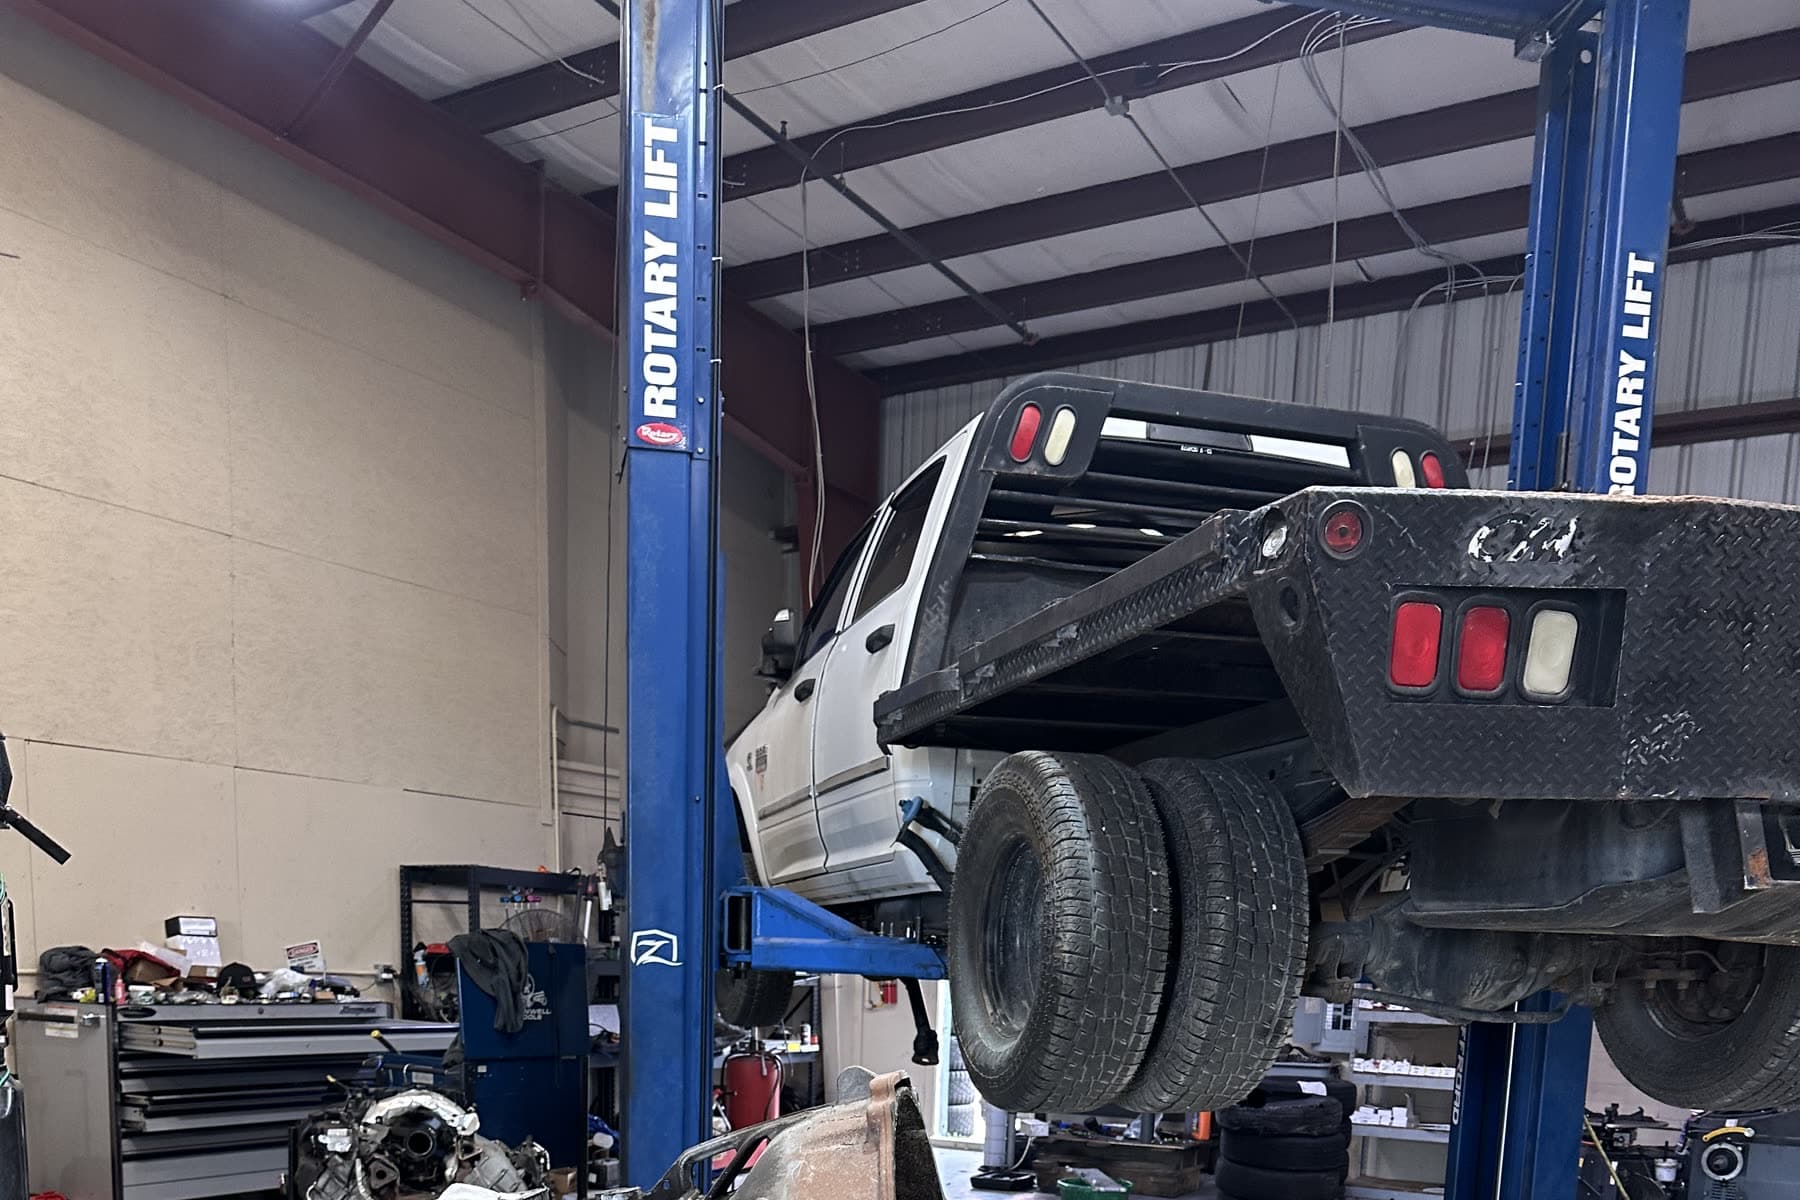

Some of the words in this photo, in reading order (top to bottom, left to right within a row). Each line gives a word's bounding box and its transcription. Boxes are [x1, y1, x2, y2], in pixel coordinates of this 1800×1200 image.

[643, 117, 678, 219] LIFT
[643, 230, 678, 418] ROTARY
[1622, 253, 1655, 339] LIFT
[1452, 1024, 1468, 1125] FFROAD
